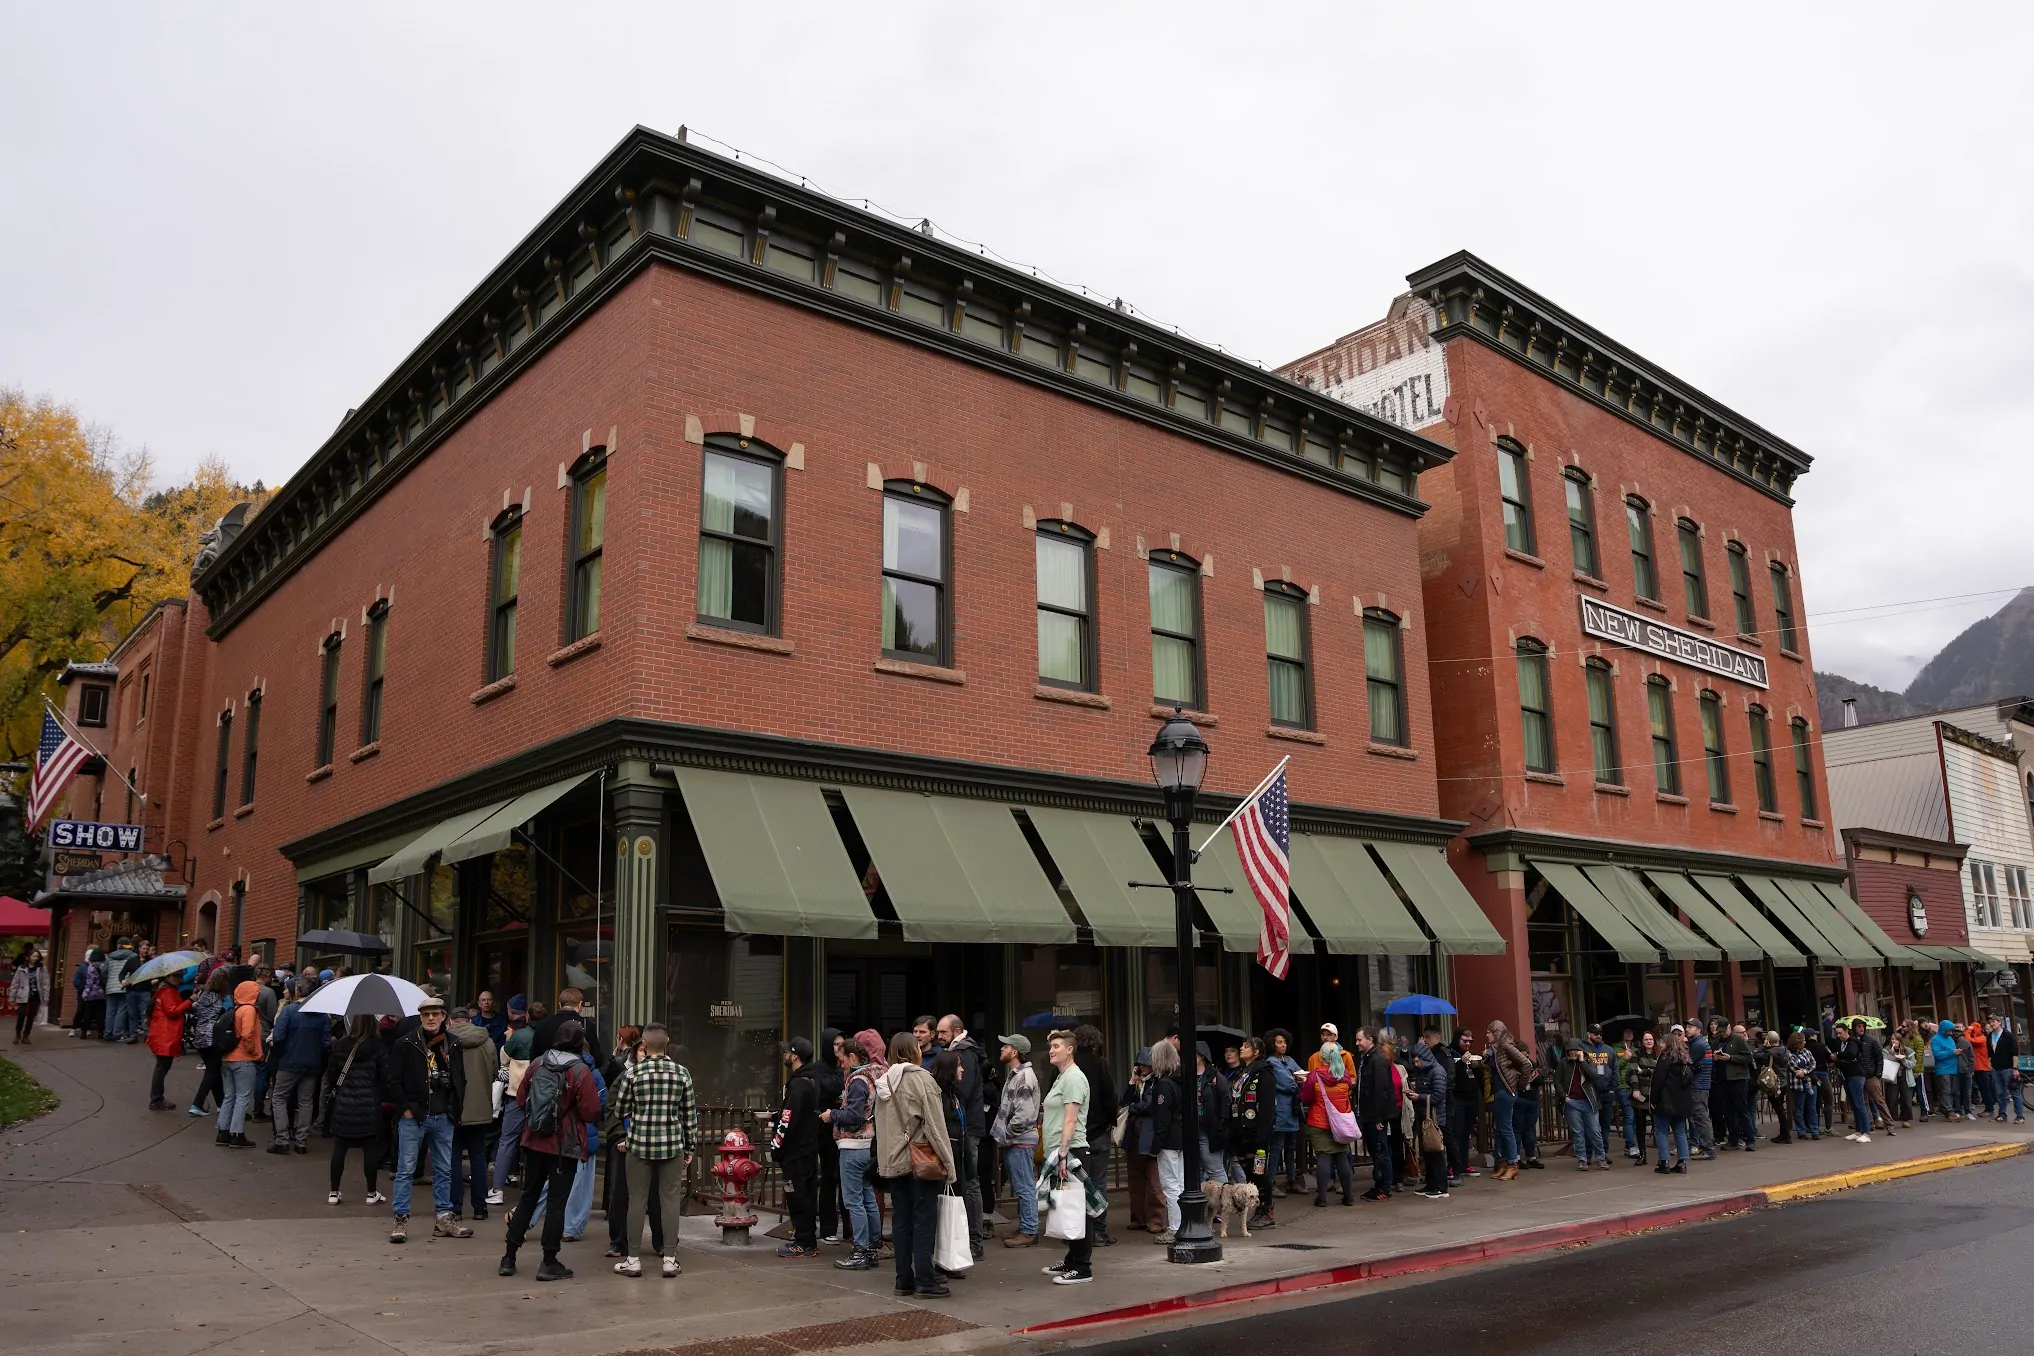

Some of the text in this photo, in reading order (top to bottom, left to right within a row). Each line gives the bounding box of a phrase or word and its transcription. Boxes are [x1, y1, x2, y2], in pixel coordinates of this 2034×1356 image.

[1586, 603, 1640, 643] NEW
[55, 823, 140, 849] SHOW
[55, 853, 101, 875] SHERIDAN
[97, 920, 149, 941] SHERIDAN
[710, 1004, 743, 1018] SHERIDAN
